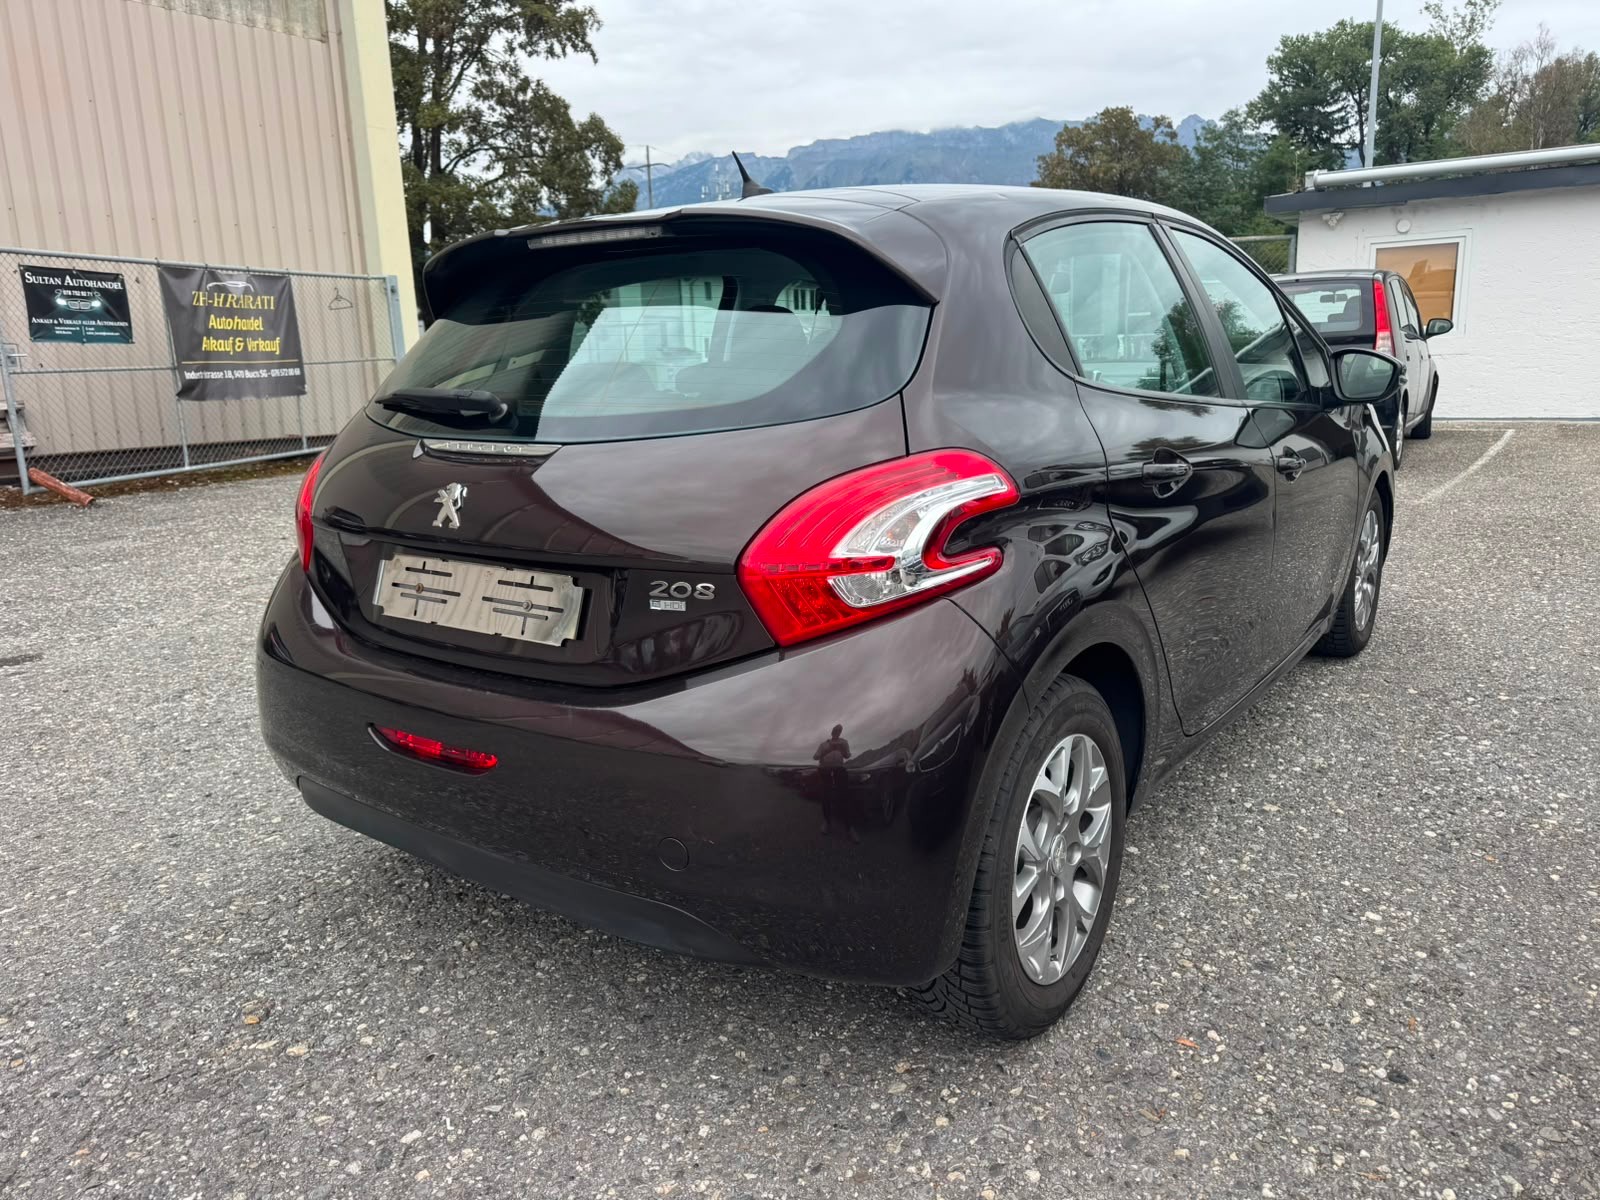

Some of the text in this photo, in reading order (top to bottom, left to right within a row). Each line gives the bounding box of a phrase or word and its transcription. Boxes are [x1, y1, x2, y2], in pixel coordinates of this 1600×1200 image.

[25, 271, 123, 290] SULTAN AUTOHANDEL
[208, 314, 264, 331] Autohandel
[235, 337, 244, 352] &
[649, 580, 715, 600] 208
